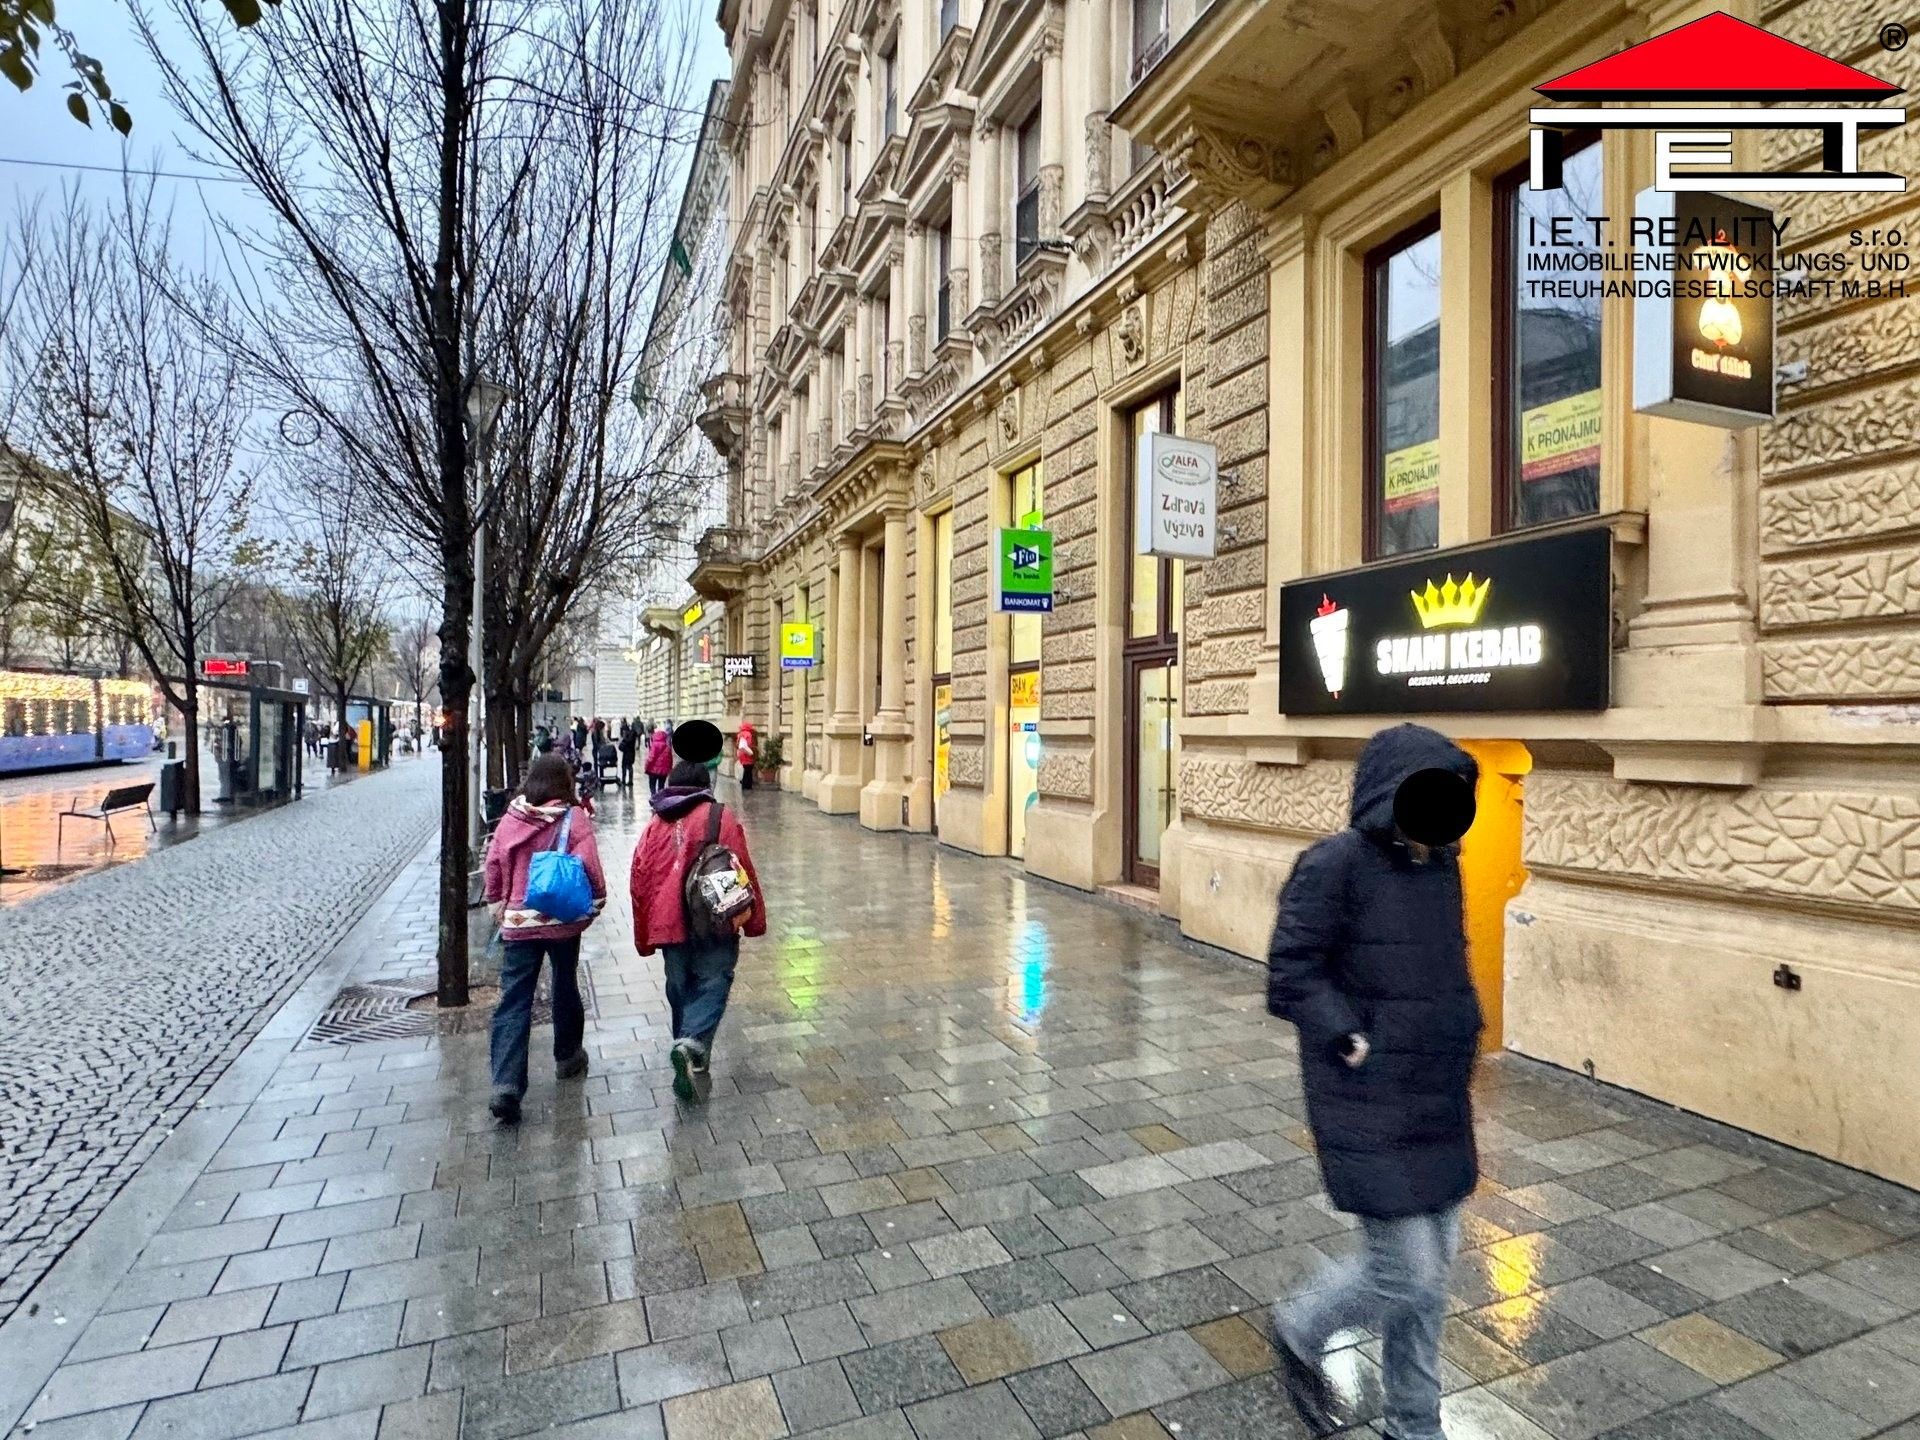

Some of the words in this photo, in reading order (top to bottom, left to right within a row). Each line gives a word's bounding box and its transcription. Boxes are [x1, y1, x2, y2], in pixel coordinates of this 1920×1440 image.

[1527, 436, 1535, 452] K
[1175, 455, 1199, 469] ALFA
[1388, 475, 1395, 490] K
[1161, 493, 1206, 516] Zdravá
[1018, 549, 1036, 565] Fio
[1004, 597, 1041, 607] BANKOMAT
[1376, 636, 1446, 675] SHAM
[1450, 625, 1542, 669] KEBAB
